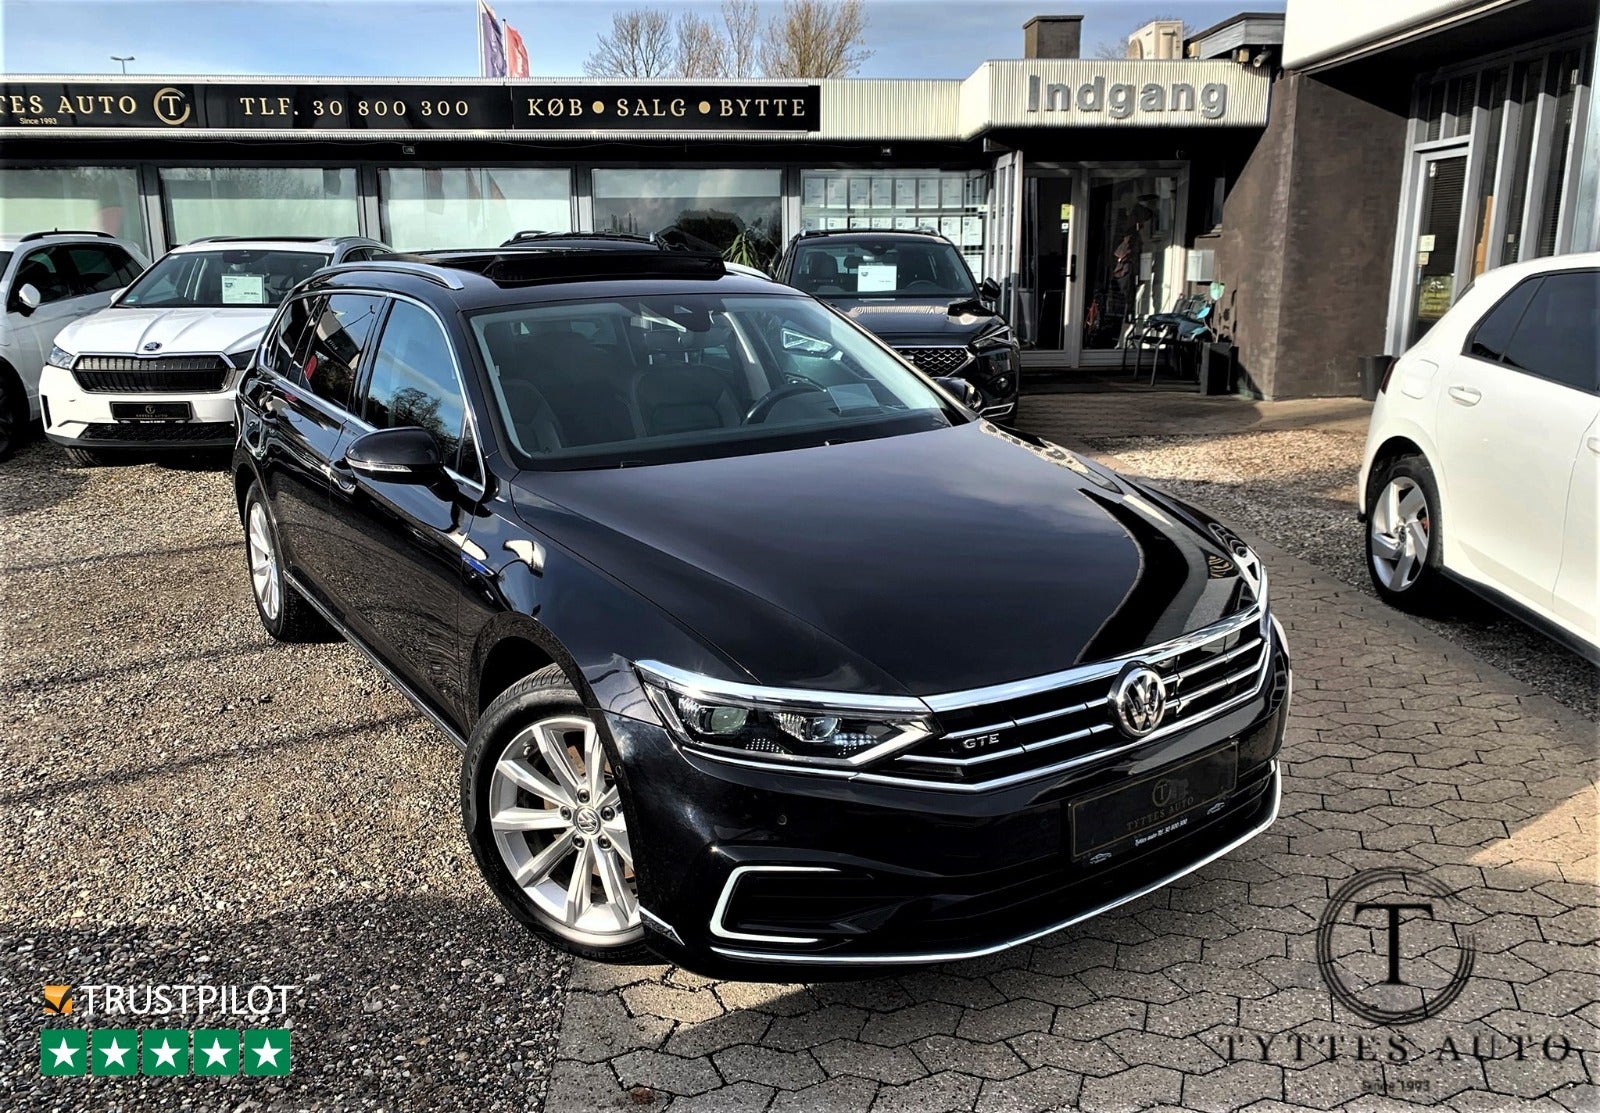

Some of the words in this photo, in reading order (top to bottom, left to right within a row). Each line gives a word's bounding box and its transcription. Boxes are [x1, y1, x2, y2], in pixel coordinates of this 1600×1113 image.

[58, 96, 136, 114] AUTO
[1027, 74, 1228, 119] Indgang
[240, 98, 298, 115] TLF.
[314, 101, 342, 115] 30
[359, 101, 405, 115] 800
[422, 101, 468, 115] 300
[528, 99, 582, 116] KØB
[618, 99, 686, 116] SALG
[720, 99, 804, 116] BYTTE
[19, 117, 39, 125] Since
[40, 117, 57, 125] 1993
[962, 733, 1000, 749] GTE
